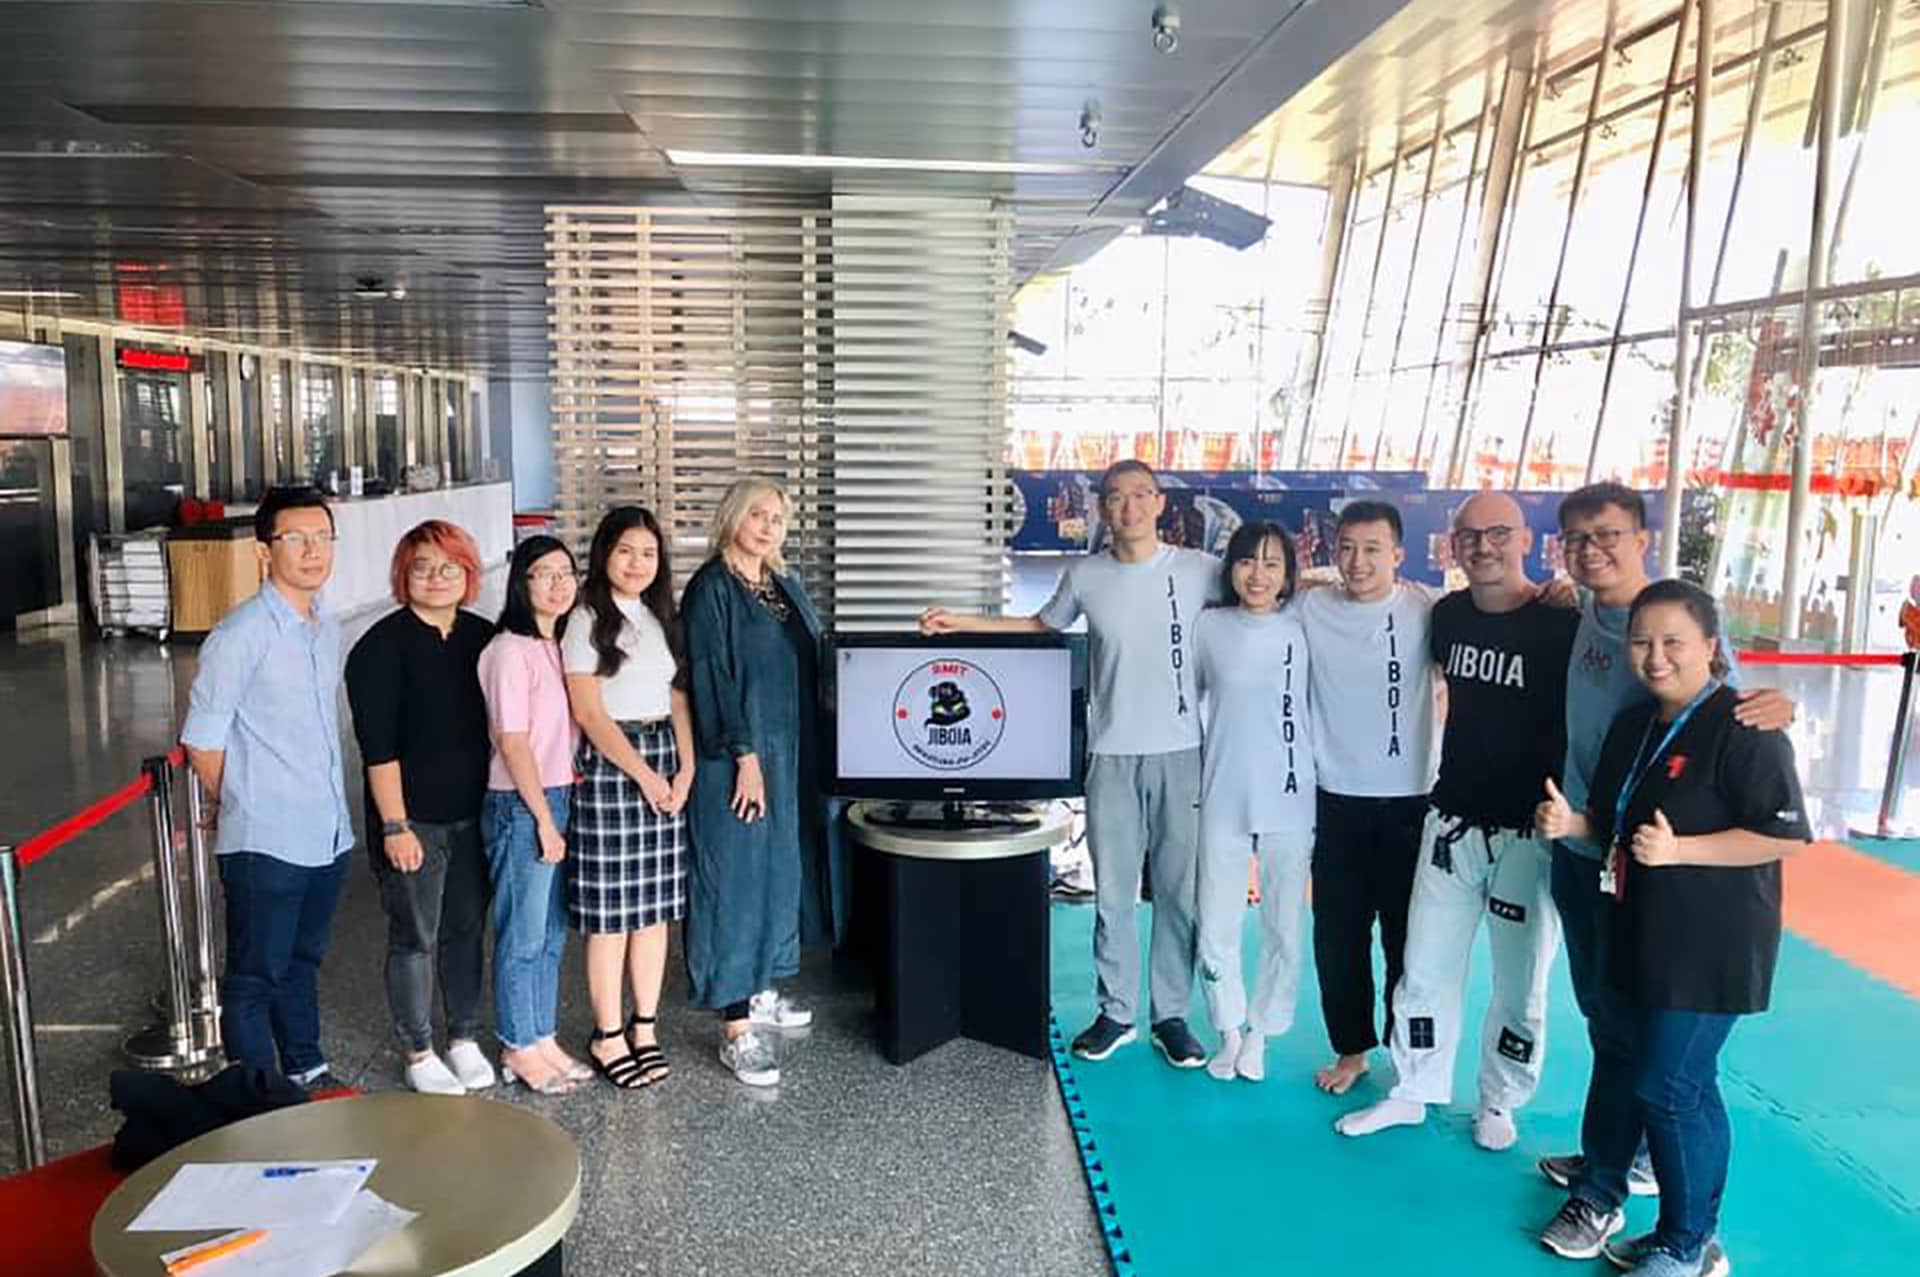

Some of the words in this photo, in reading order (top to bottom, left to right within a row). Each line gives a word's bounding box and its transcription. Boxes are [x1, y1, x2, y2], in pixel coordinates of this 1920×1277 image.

[1167, 574, 1188, 716] JIBOIA
[1384, 612, 1401, 758] JIBOIA
[1446, 642, 1526, 688] JIBOIA
[927, 727, 972, 746] JIBOIA
[1282, 642, 1298, 795] JIBOIA
